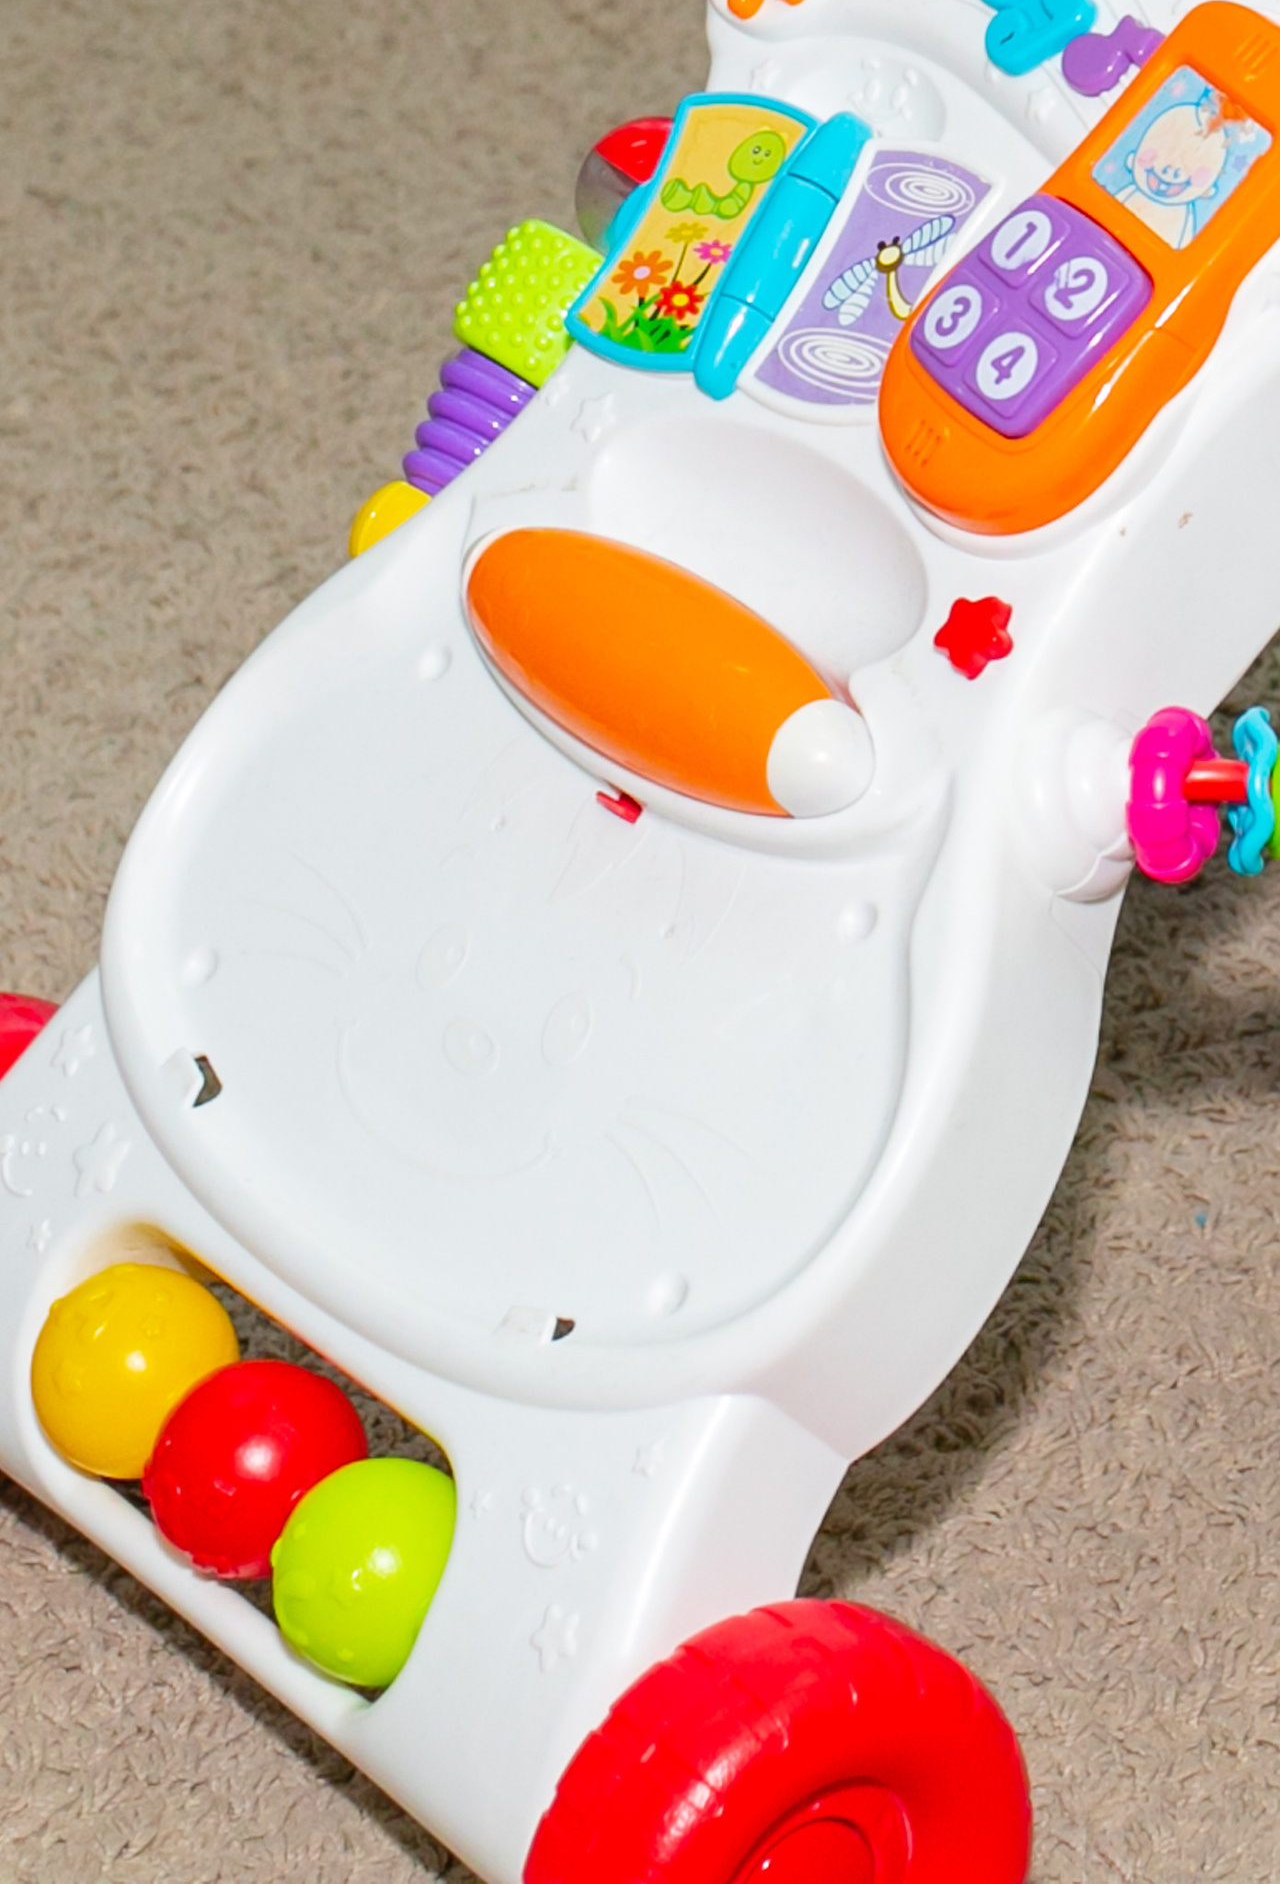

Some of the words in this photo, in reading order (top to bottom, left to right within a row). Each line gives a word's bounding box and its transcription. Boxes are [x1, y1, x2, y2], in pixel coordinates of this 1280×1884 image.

[1005, 221, 1038, 259] 1
[1053, 267, 1096, 310] 2
[935, 296, 972, 337] 3
[991, 345, 1026, 385] 4
